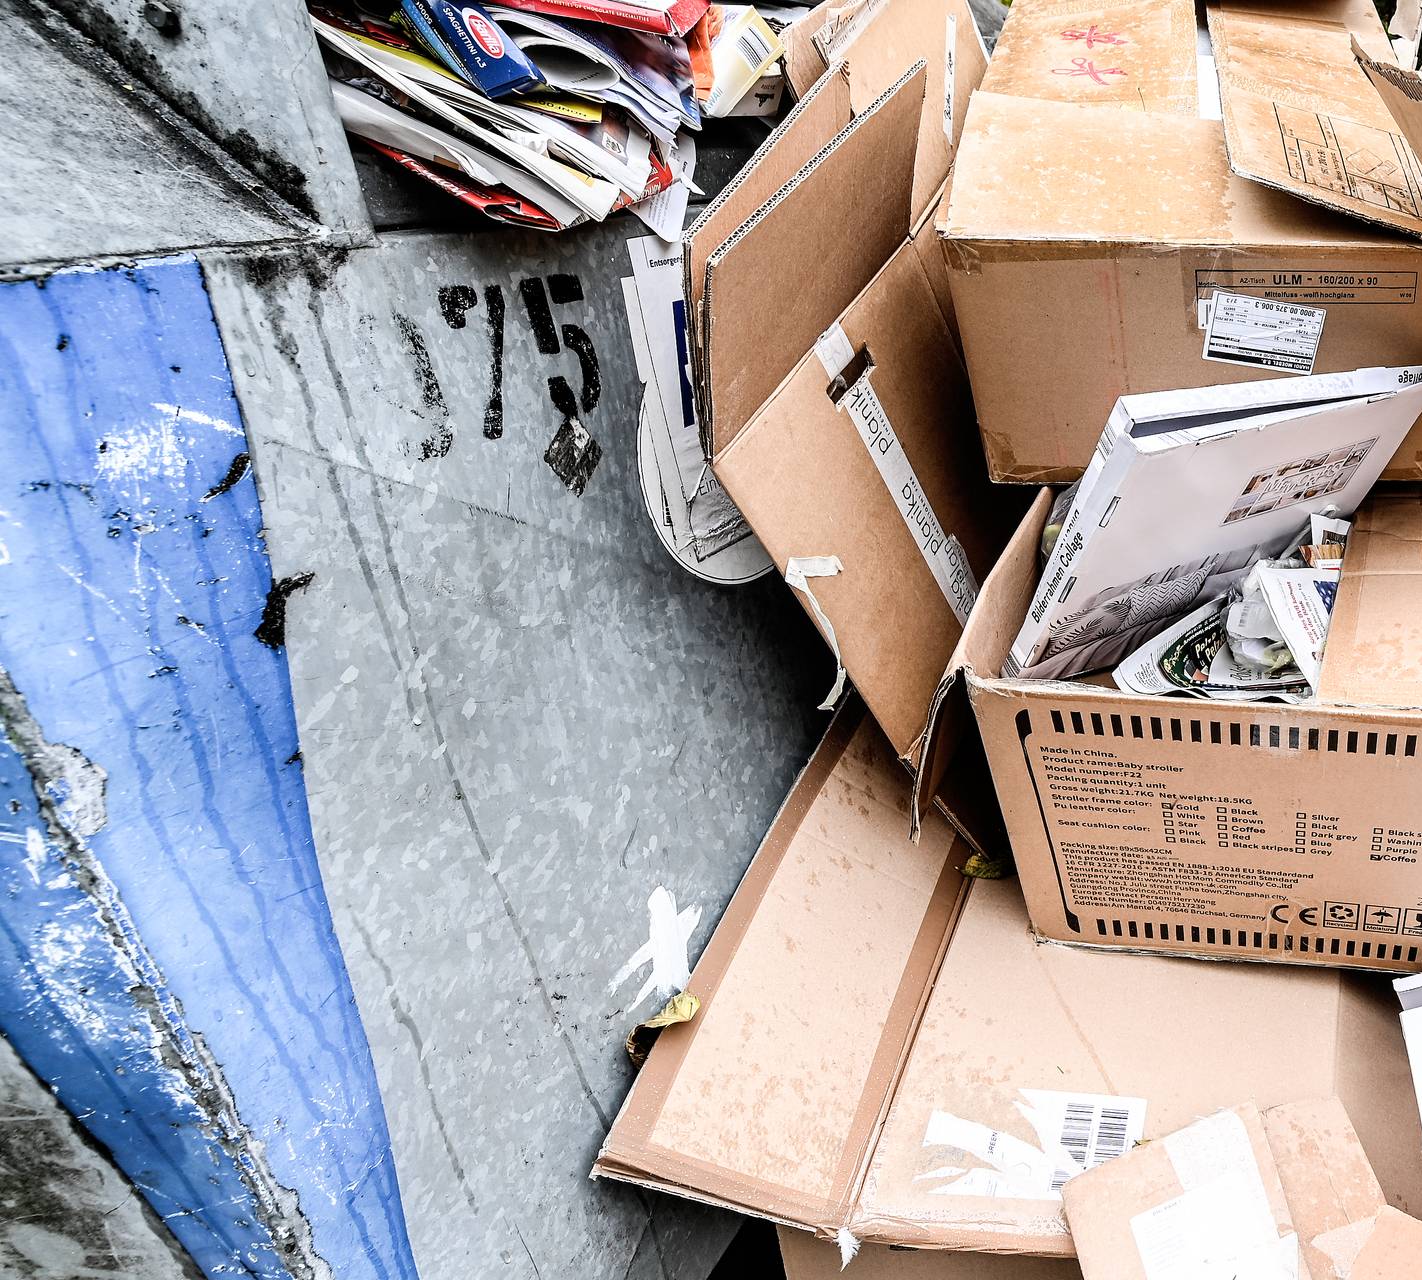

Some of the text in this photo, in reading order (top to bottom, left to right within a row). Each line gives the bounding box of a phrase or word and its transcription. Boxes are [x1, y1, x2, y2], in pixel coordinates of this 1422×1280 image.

[443, 7, 477, 56] SPAGHETTINI
[473, 19, 500, 54] Barilla
[1273, 275, 1302, 285] ULM
[1319, 276, 1354, 285] 160/200
[1367, 277, 1378, 285] 90
[698, 477, 721, 496] Ein
[901, 483, 943, 556] planika
[1031, 567, 1065, 624] Bilderrahmen
[1059, 531, 1083, 568] Collage
[1045, 765, 1077, 773] Model
[1146, 764, 1184, 773] stroller
[1047, 774, 1088, 784] Packing
[1051, 794, 1089, 803] Stroller
[1092, 797, 1121, 805] frame
[1159, 792, 1177, 800] Net
[1069, 803, 1105, 812] leather
[1231, 808, 1258, 816] Black
[1311, 814, 1340, 822] Silver
[1058, 819, 1079, 827] Seat
[1082, 822, 1120, 830] cushion
[1177, 812, 1206, 820] White
[1231, 817, 1263, 825] Brown
[1388, 829, 1415, 837] Black
[1231, 825, 1266, 834] Coffee
[1180, 837, 1206, 845] Black
[1261, 844, 1294, 852] stripes
[1310, 848, 1332, 856] Grey
[1384, 855, 1417, 864] Coffee
[1386, 847, 1418, 855] Purple
